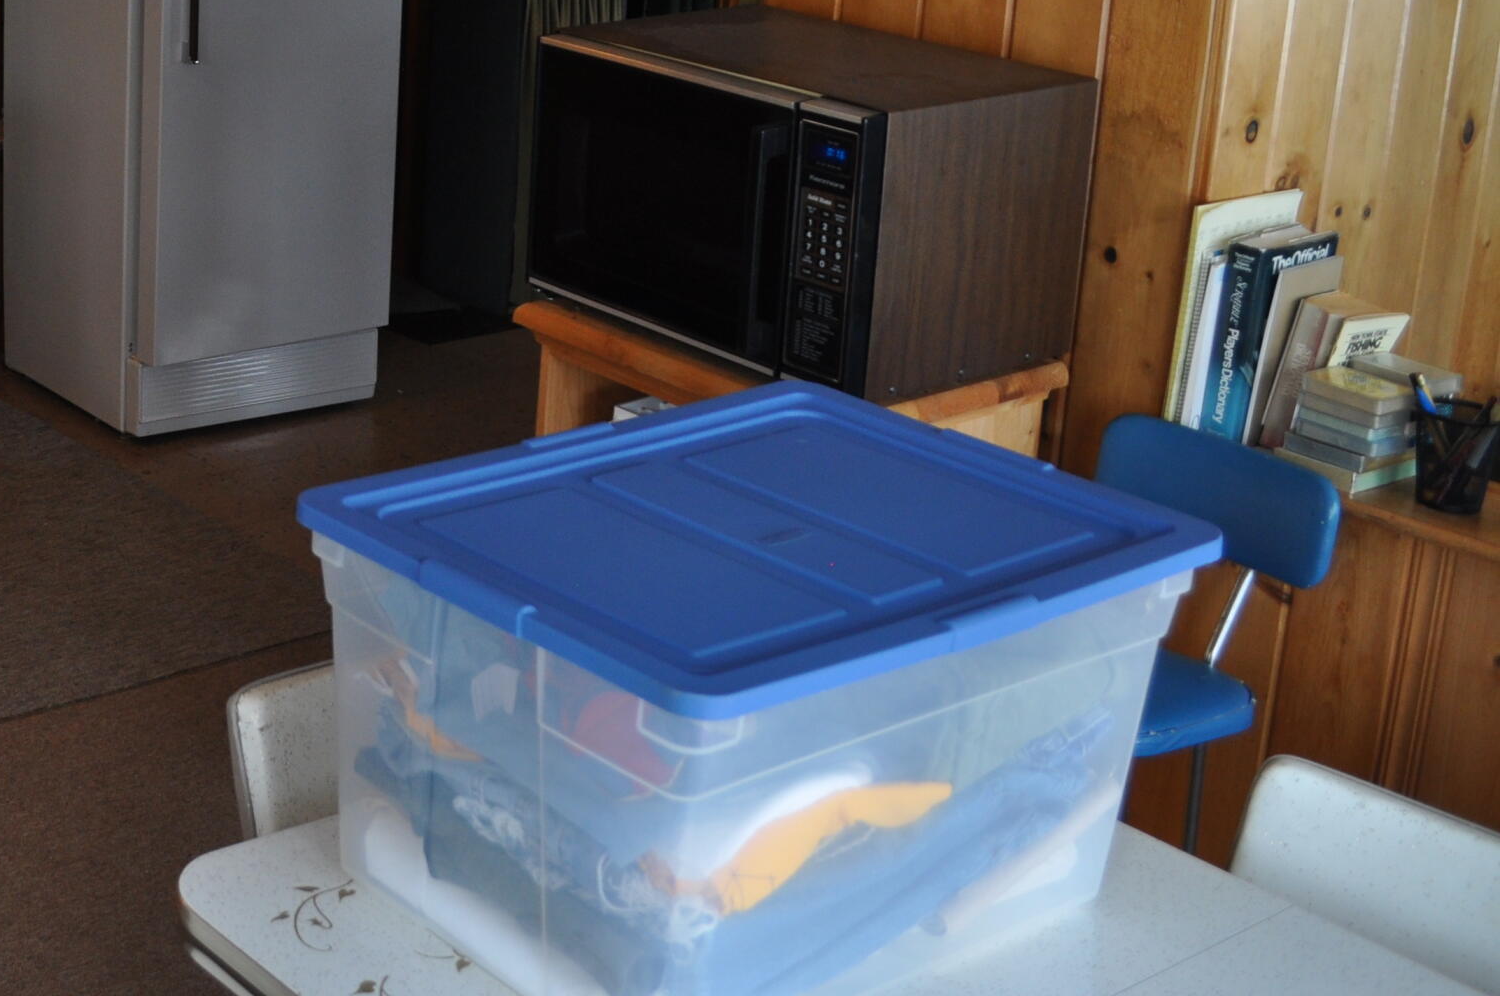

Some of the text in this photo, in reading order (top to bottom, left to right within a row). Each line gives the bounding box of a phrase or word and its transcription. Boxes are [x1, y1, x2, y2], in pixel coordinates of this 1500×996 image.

[1272, 243, 1330, 275] The Official
[1222, 328, 1240, 369] Players
[1345, 336, 1383, 354] FISHING
[1212, 369, 1233, 424] Dictionary
